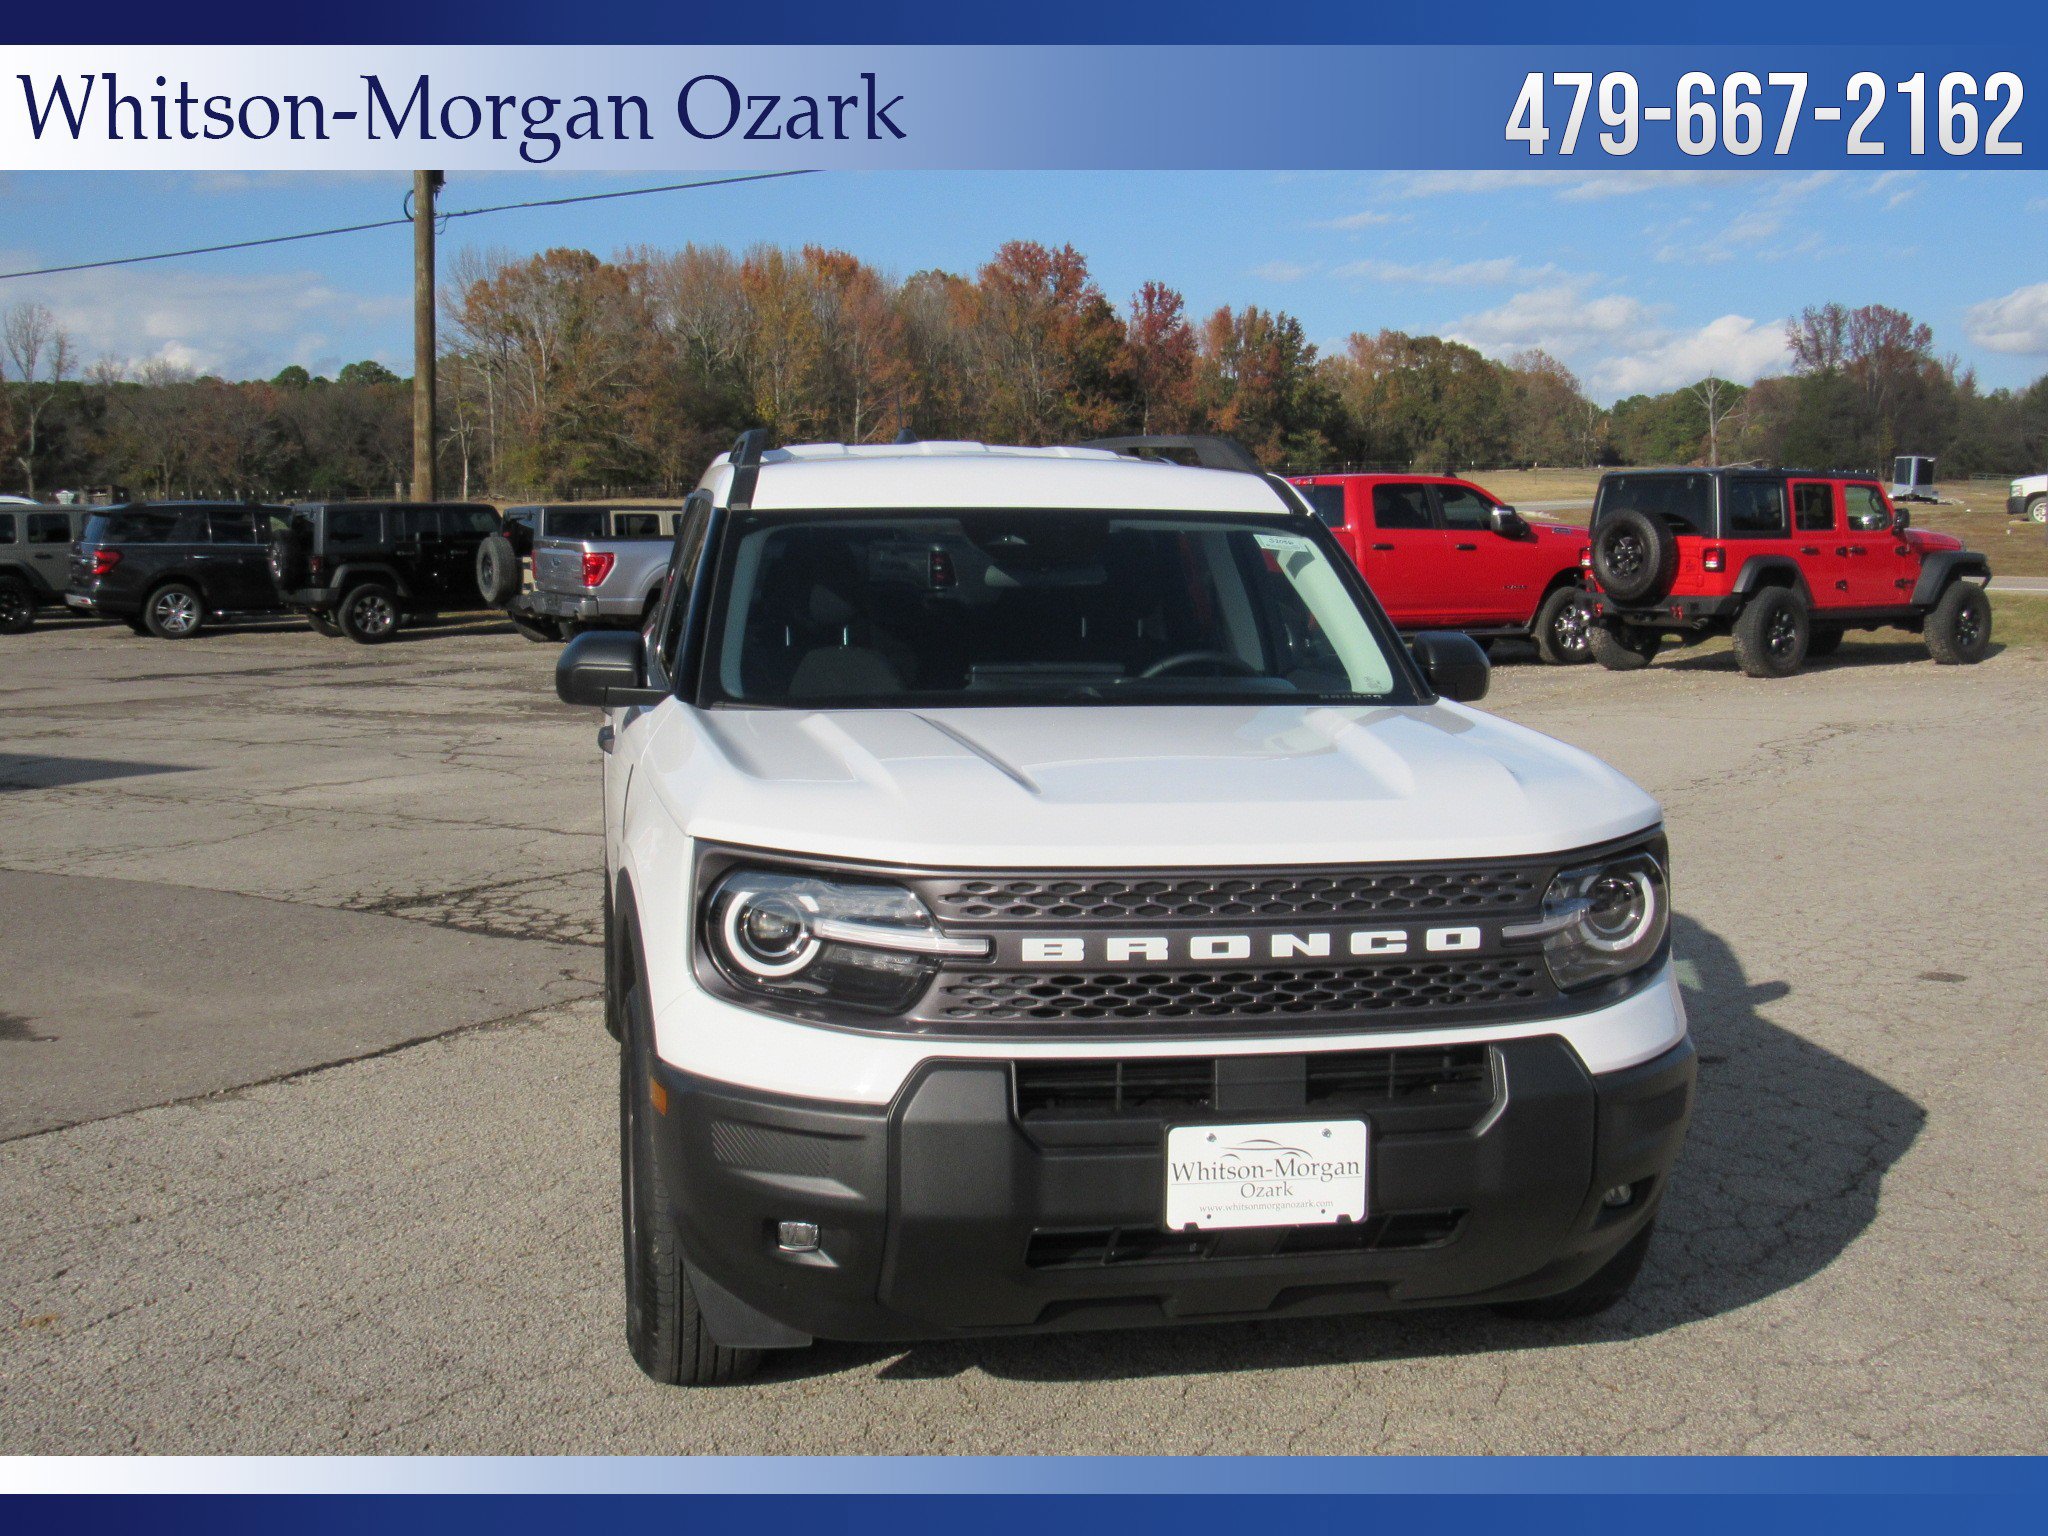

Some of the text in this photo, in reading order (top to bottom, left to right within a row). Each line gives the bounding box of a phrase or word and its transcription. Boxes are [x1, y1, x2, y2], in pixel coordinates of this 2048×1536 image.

[1021, 926, 1481, 962] BRONCO
[1172, 1158, 1360, 1182] Whitson-Morgan
[1240, 1181, 1294, 1199] Ozark
[1199, 1199, 1334, 1212] www.whitsonmorganozark.com
